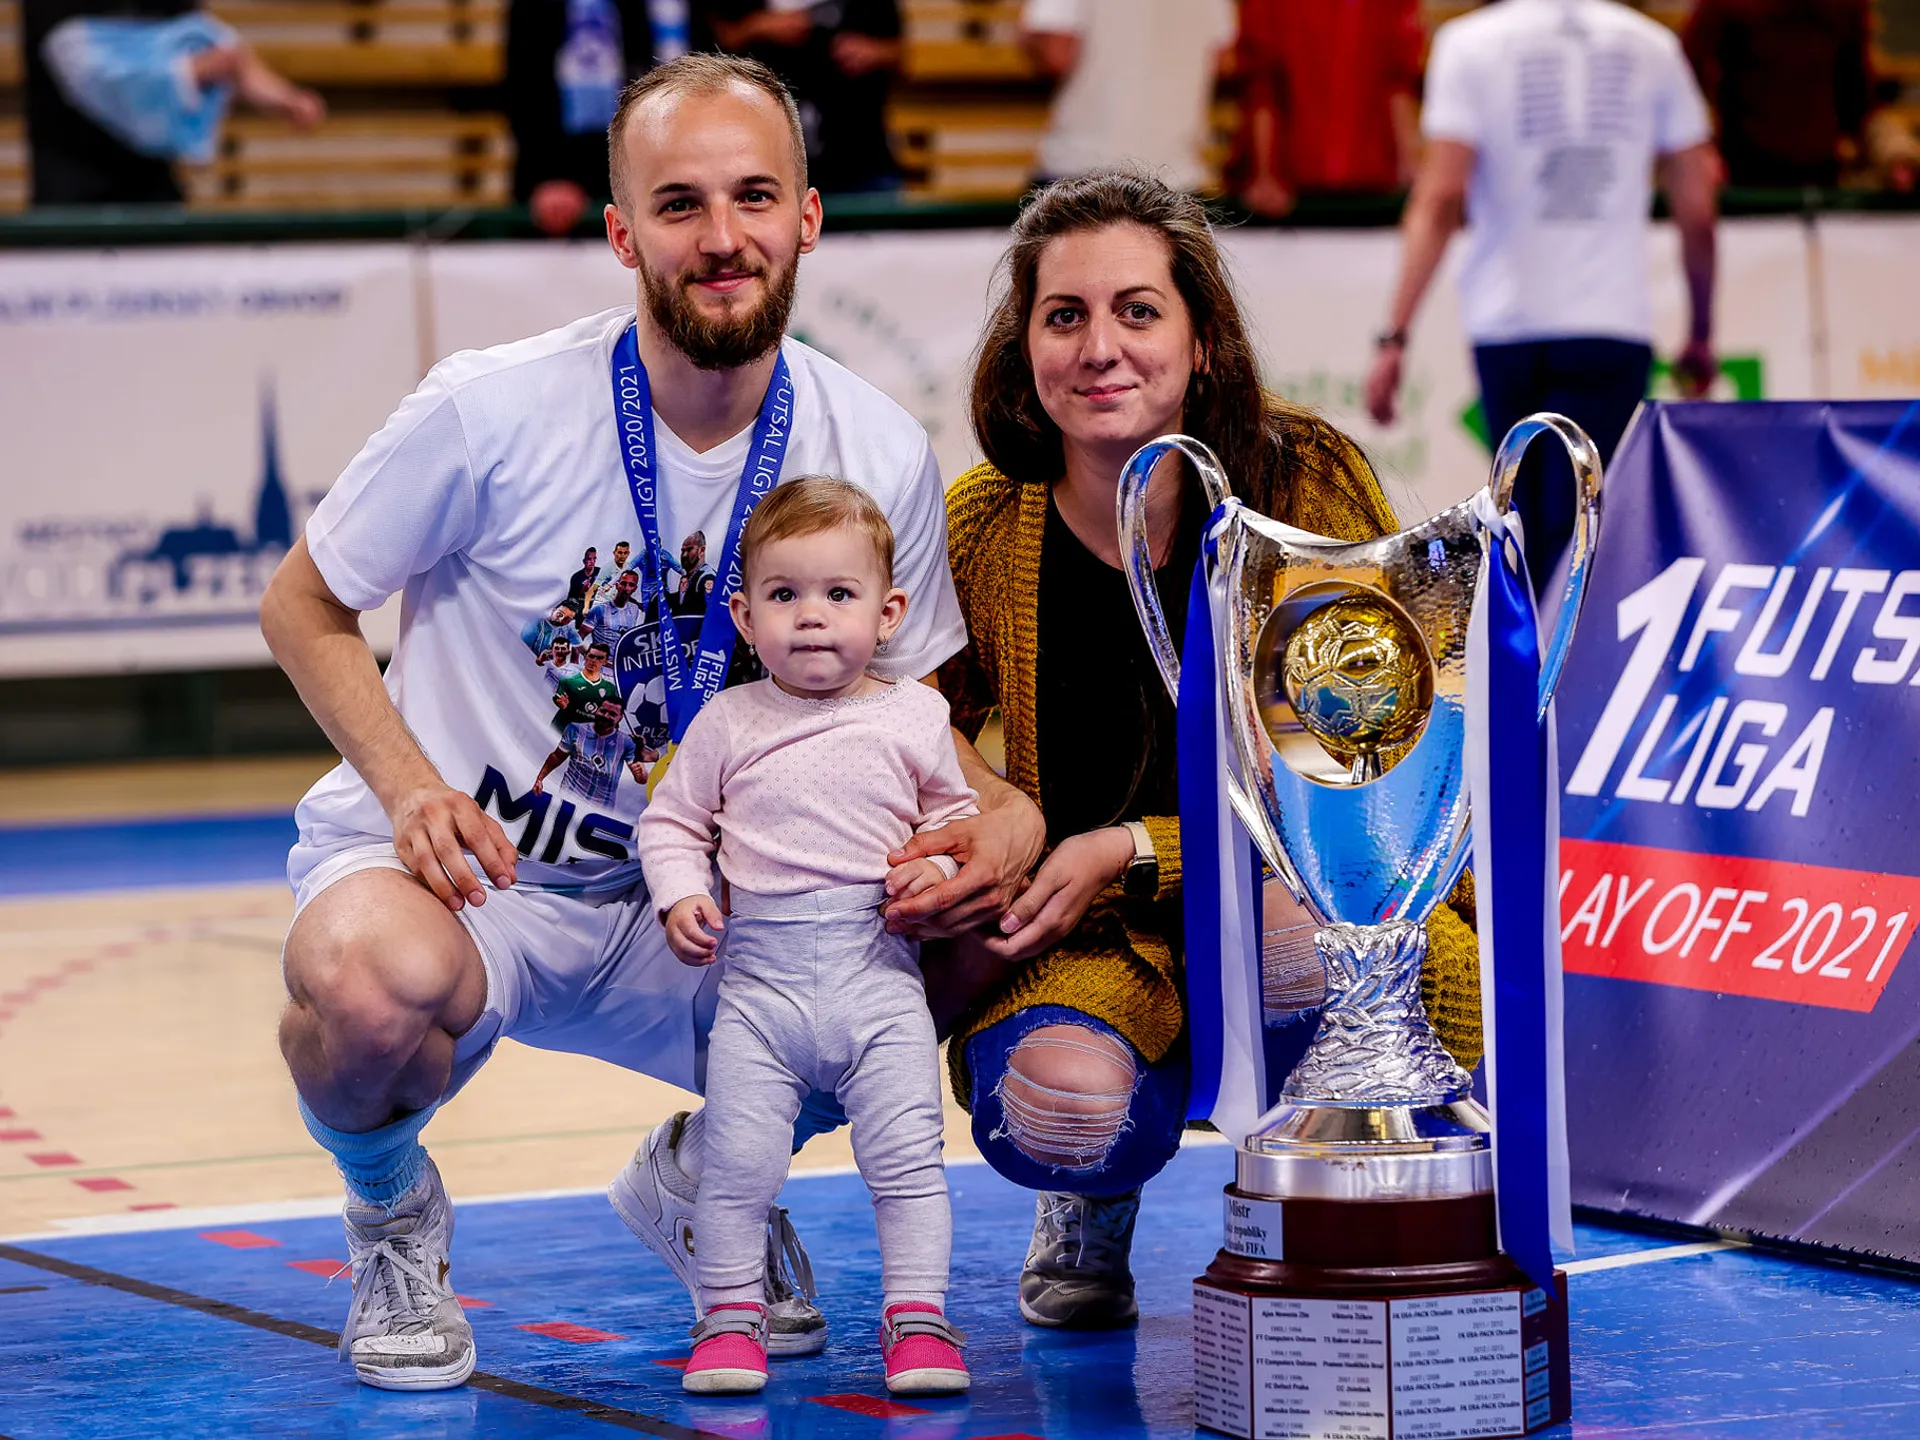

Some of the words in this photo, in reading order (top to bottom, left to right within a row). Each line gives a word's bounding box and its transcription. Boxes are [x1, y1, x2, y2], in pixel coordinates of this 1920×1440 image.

[620, 364, 649, 470] 2020/2021
[762, 375, 793, 450] FUTSAL
[750, 455, 777, 500] LIGY
[663, 628, 683, 691] MISTR
[1679, 563, 1920, 686] FUTS
[692, 658, 711, 689] LIGA
[1566, 557, 1706, 796] 1
[642, 726, 670, 740] PLZ
[1615, 694, 1834, 817] LIGA
[1642, 882, 1769, 963] OFF
[1751, 898, 1909, 982] 2021
[1245, 1241, 1266, 1255] FIFA
